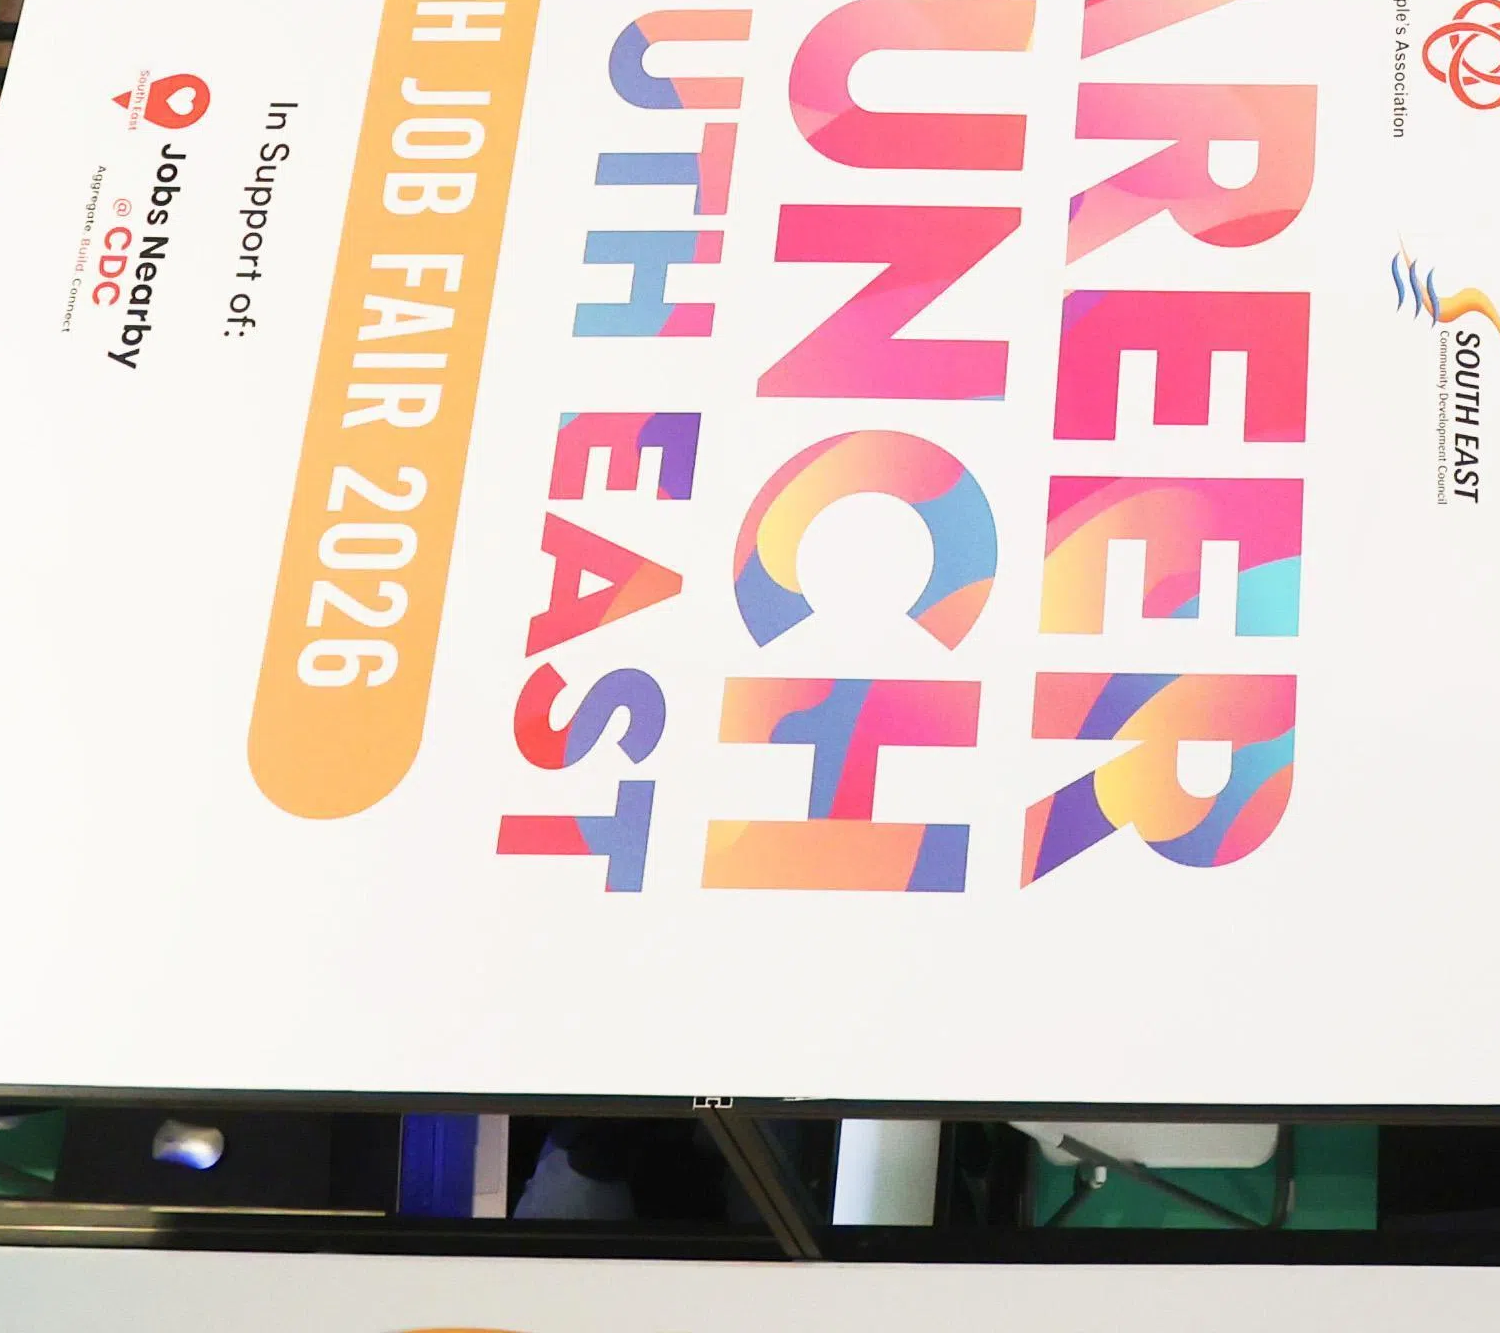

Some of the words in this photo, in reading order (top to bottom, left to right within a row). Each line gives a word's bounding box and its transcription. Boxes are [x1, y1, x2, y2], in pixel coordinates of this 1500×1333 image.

[266, 103, 298, 129] In
[1392, 40, 1409, 138] Association
[147, 143, 186, 225] Jobs
[382, 74, 493, 217] JOB
[113, 198, 132, 216] @
[236, 143, 289, 281] Support
[62, 278, 82, 333] Connect
[92, 227, 132, 305] CDC
[108, 237, 169, 369] Nearby
[224, 294, 255, 336] of:
[339, 252, 462, 430] FAIR
[1437, 331, 1449, 390] Community
[1455, 331, 1480, 427] SOUTH
[1437, 391, 1449, 462] Development
[1437, 464, 1448, 505] Council
[1454, 434, 1479, 503] EAST
[295, 464, 420, 690] 2026
[495, 412, 701, 892] EAST
